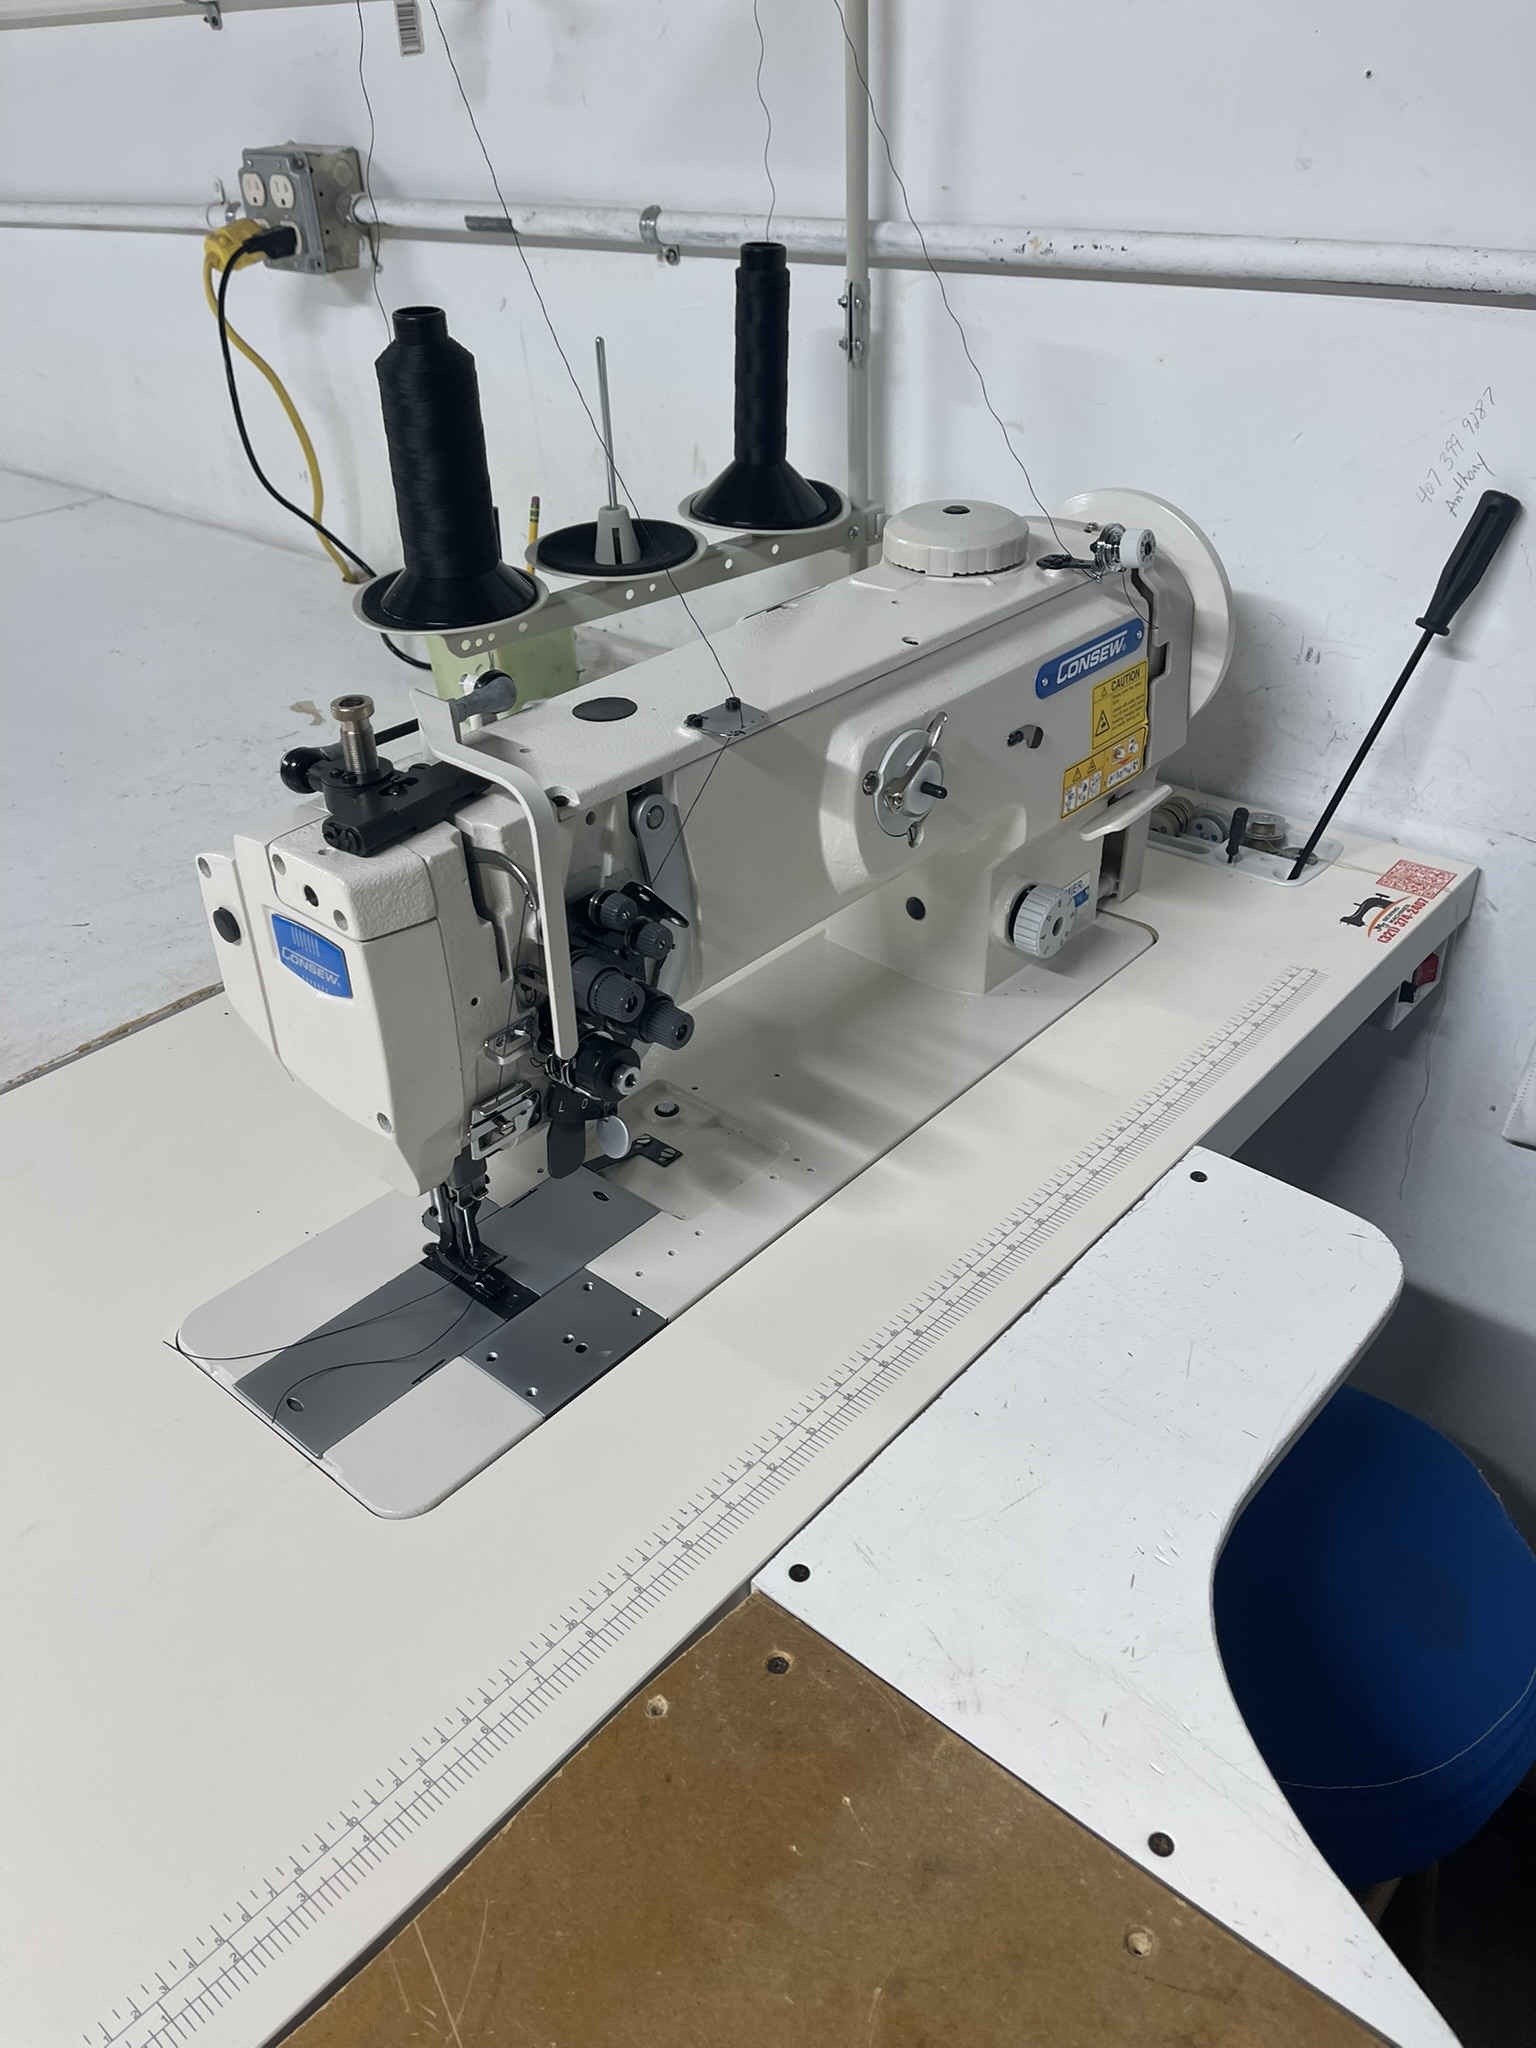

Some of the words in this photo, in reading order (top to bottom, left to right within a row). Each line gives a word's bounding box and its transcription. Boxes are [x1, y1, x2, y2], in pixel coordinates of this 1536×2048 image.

[1416, 468, 1442, 503] 407
[1440, 434, 1464, 471] 399
[1462, 386, 1495, 434] 9287
[1445, 452, 1497, 518] Anthony
[1057, 630, 1128, 684] CONSEW
[1111, 668, 1140, 692] CAUTION
[1377, 926, 1400, 943] (321)
[1394, 898, 1429, 927] 374-2407
[281, 946, 340, 985] CONSEW
[230, 1952, 240, 1964] 2
[297, 1892, 306, 1902] 3
[363, 1834, 370, 1843] 4
[422, 1778, 432, 1787] 5
[480, 1726, 489, 1734] 6
[682, 1540, 693, 1549] 10
[766, 1462, 778, 1471] 12
[131, 2010, 140, 2020] 2
[159, 1985, 167, 1994] 3
